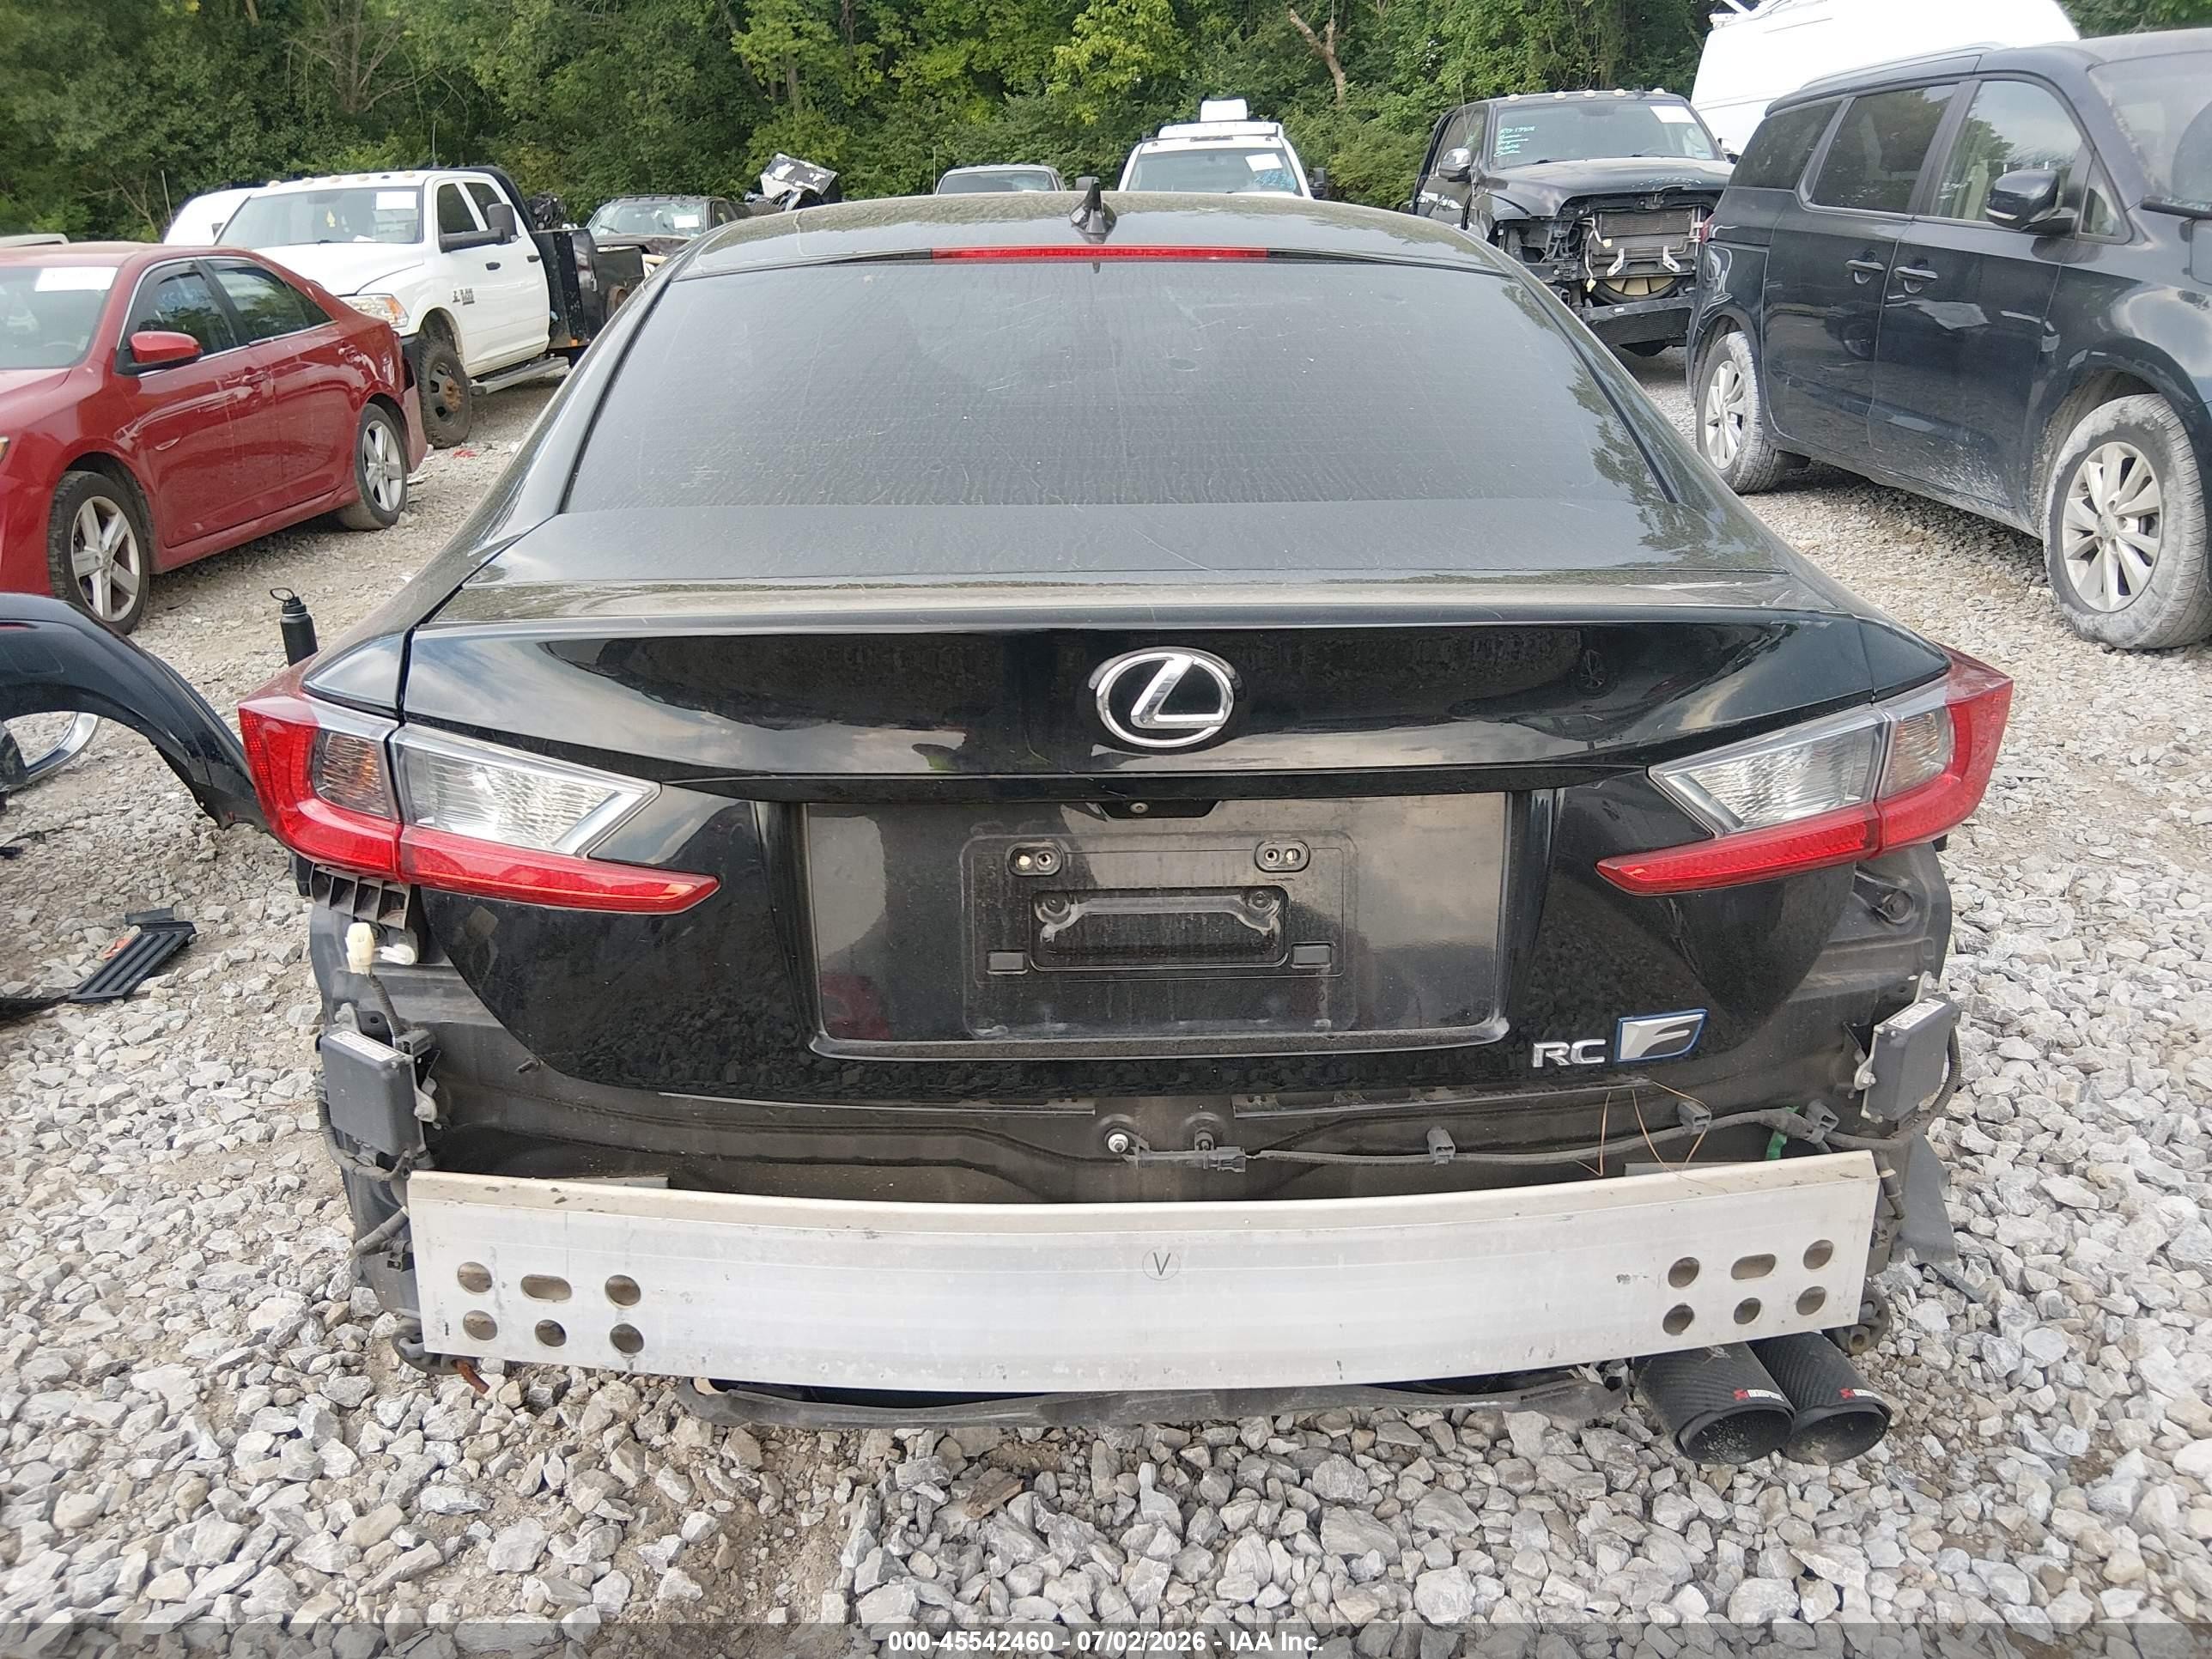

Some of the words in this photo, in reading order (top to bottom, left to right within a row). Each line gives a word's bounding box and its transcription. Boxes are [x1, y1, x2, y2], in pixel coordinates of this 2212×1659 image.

[1532, 1038, 1607, 1068] RC
[1619, 1012, 1705, 1061] F
[1152, 1251, 1171, 1276] V
